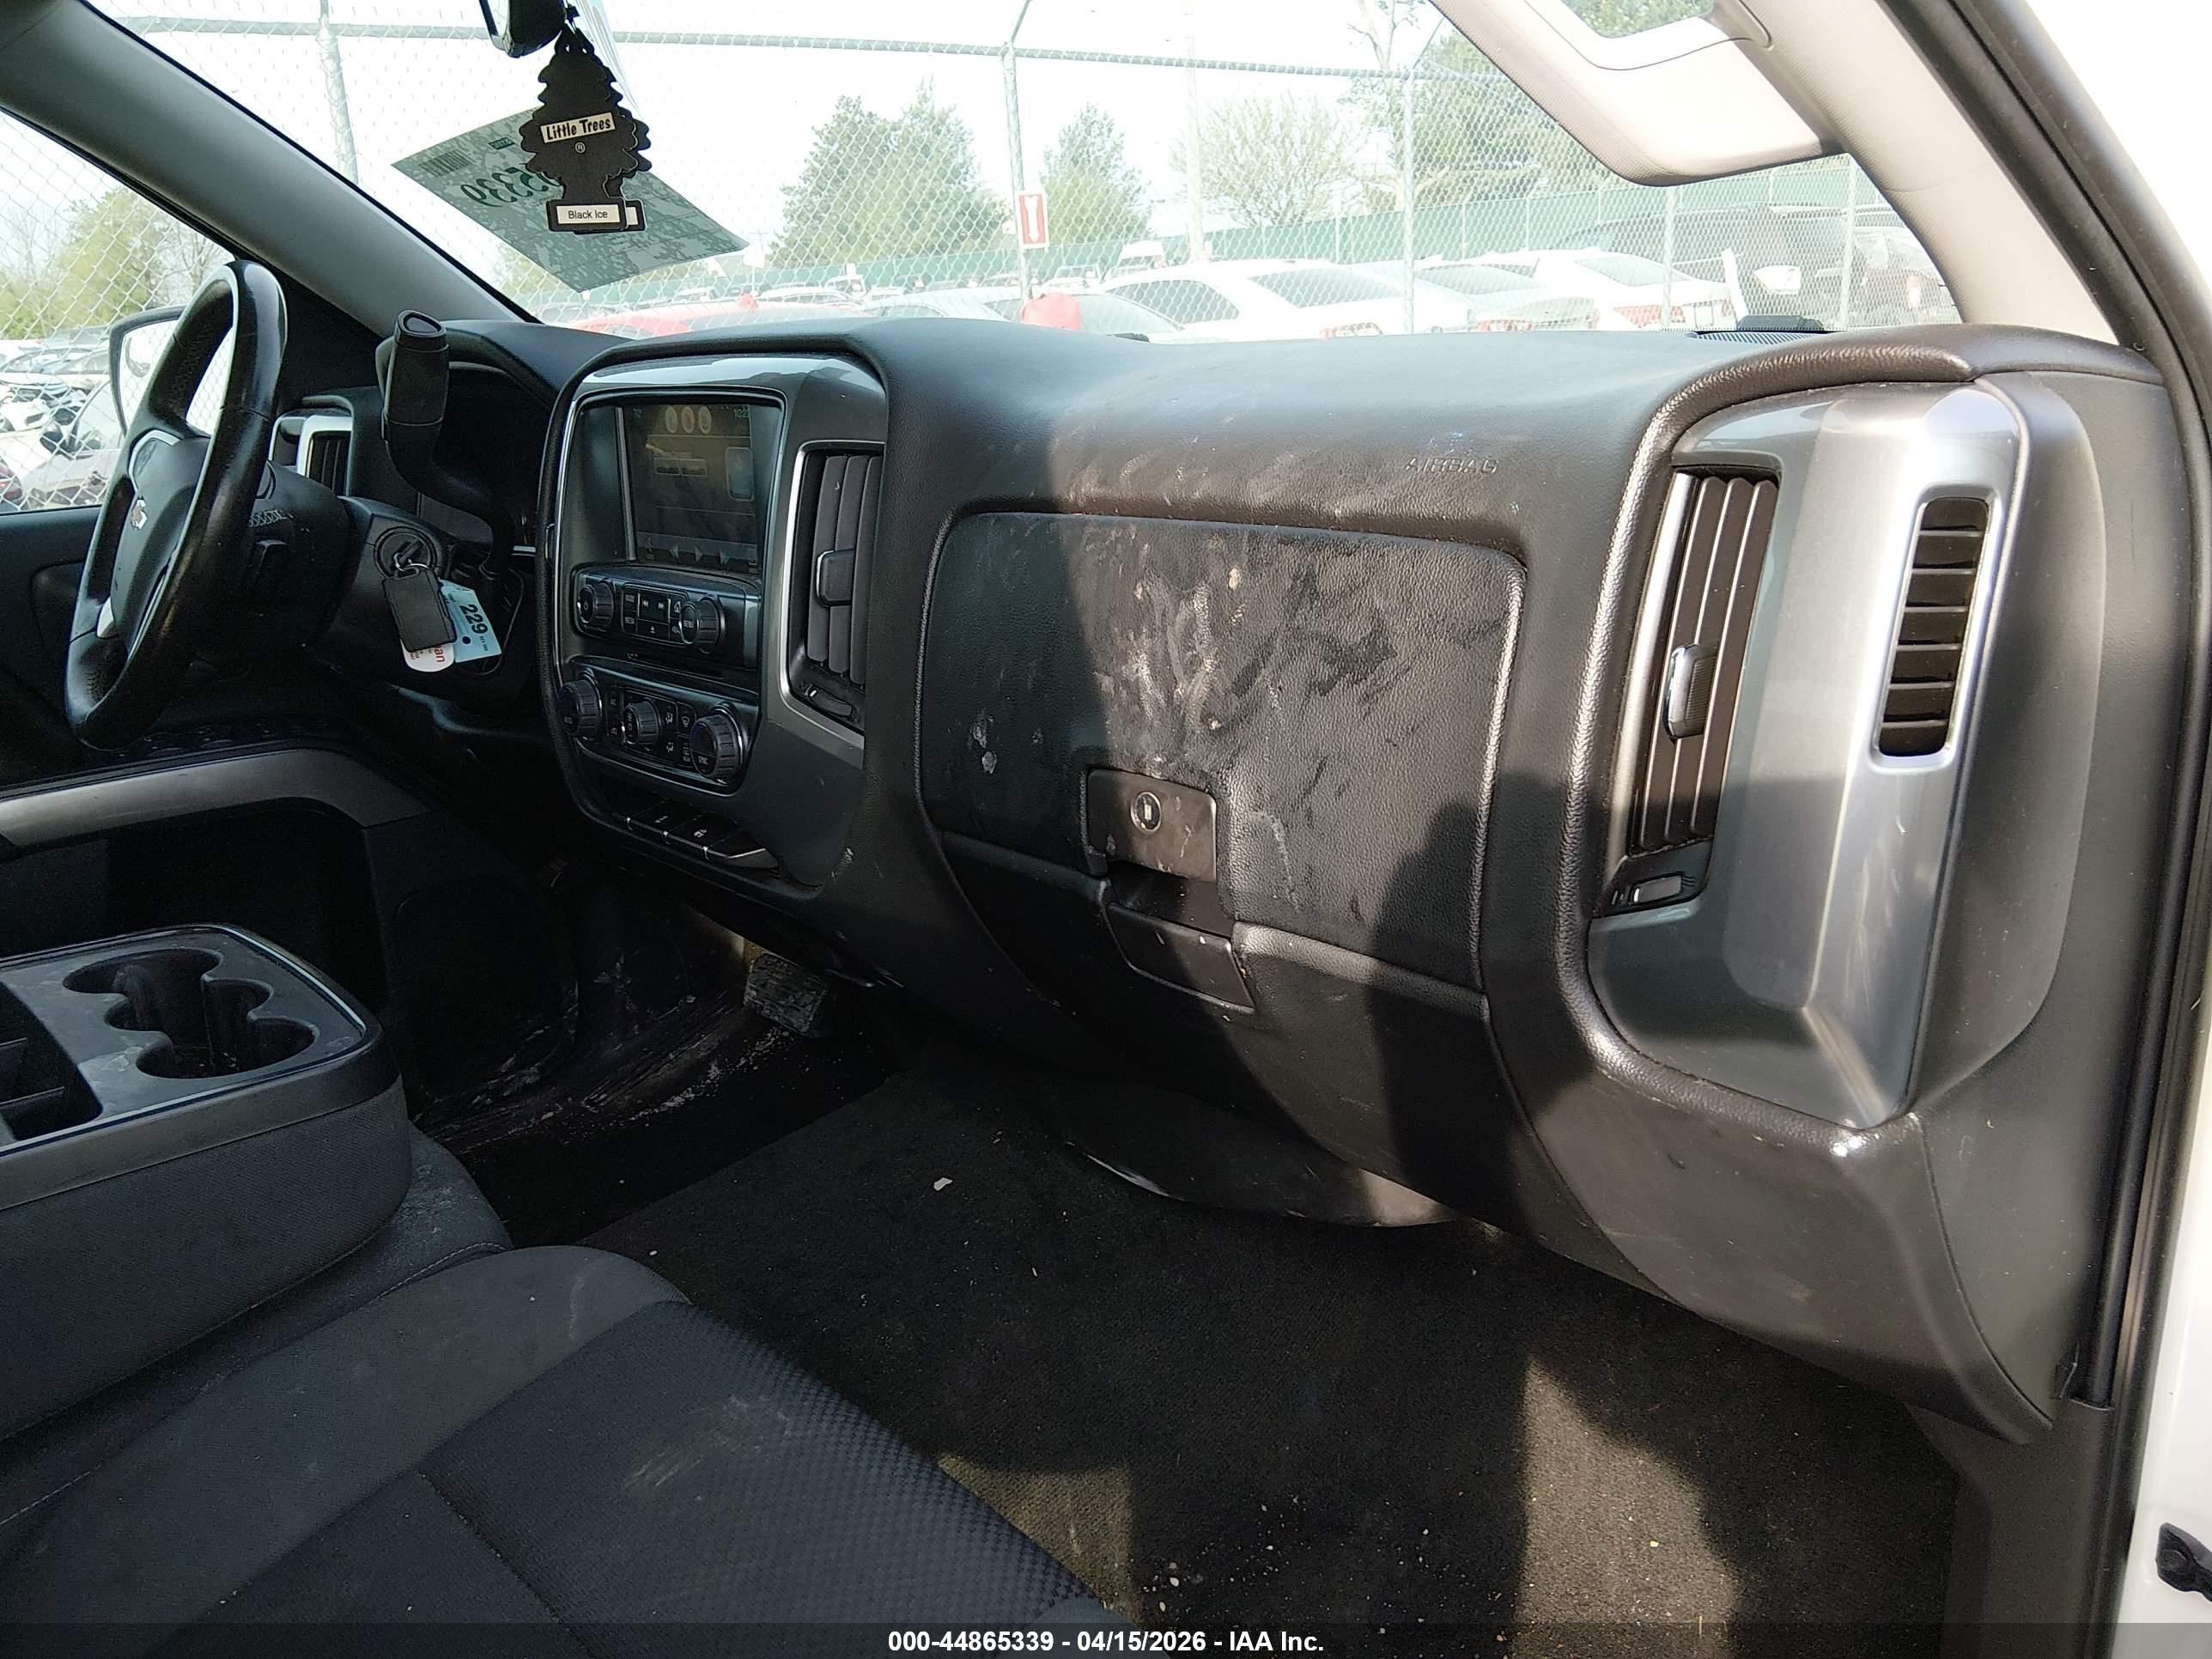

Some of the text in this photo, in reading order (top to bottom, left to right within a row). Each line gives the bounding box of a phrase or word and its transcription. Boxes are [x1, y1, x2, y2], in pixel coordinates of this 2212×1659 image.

[546, 118, 611, 141] Little Trees
[568, 210, 608, 219] Black Ice
[1406, 457, 1499, 473] AIRBAG
[459, 604, 489, 634] 229
